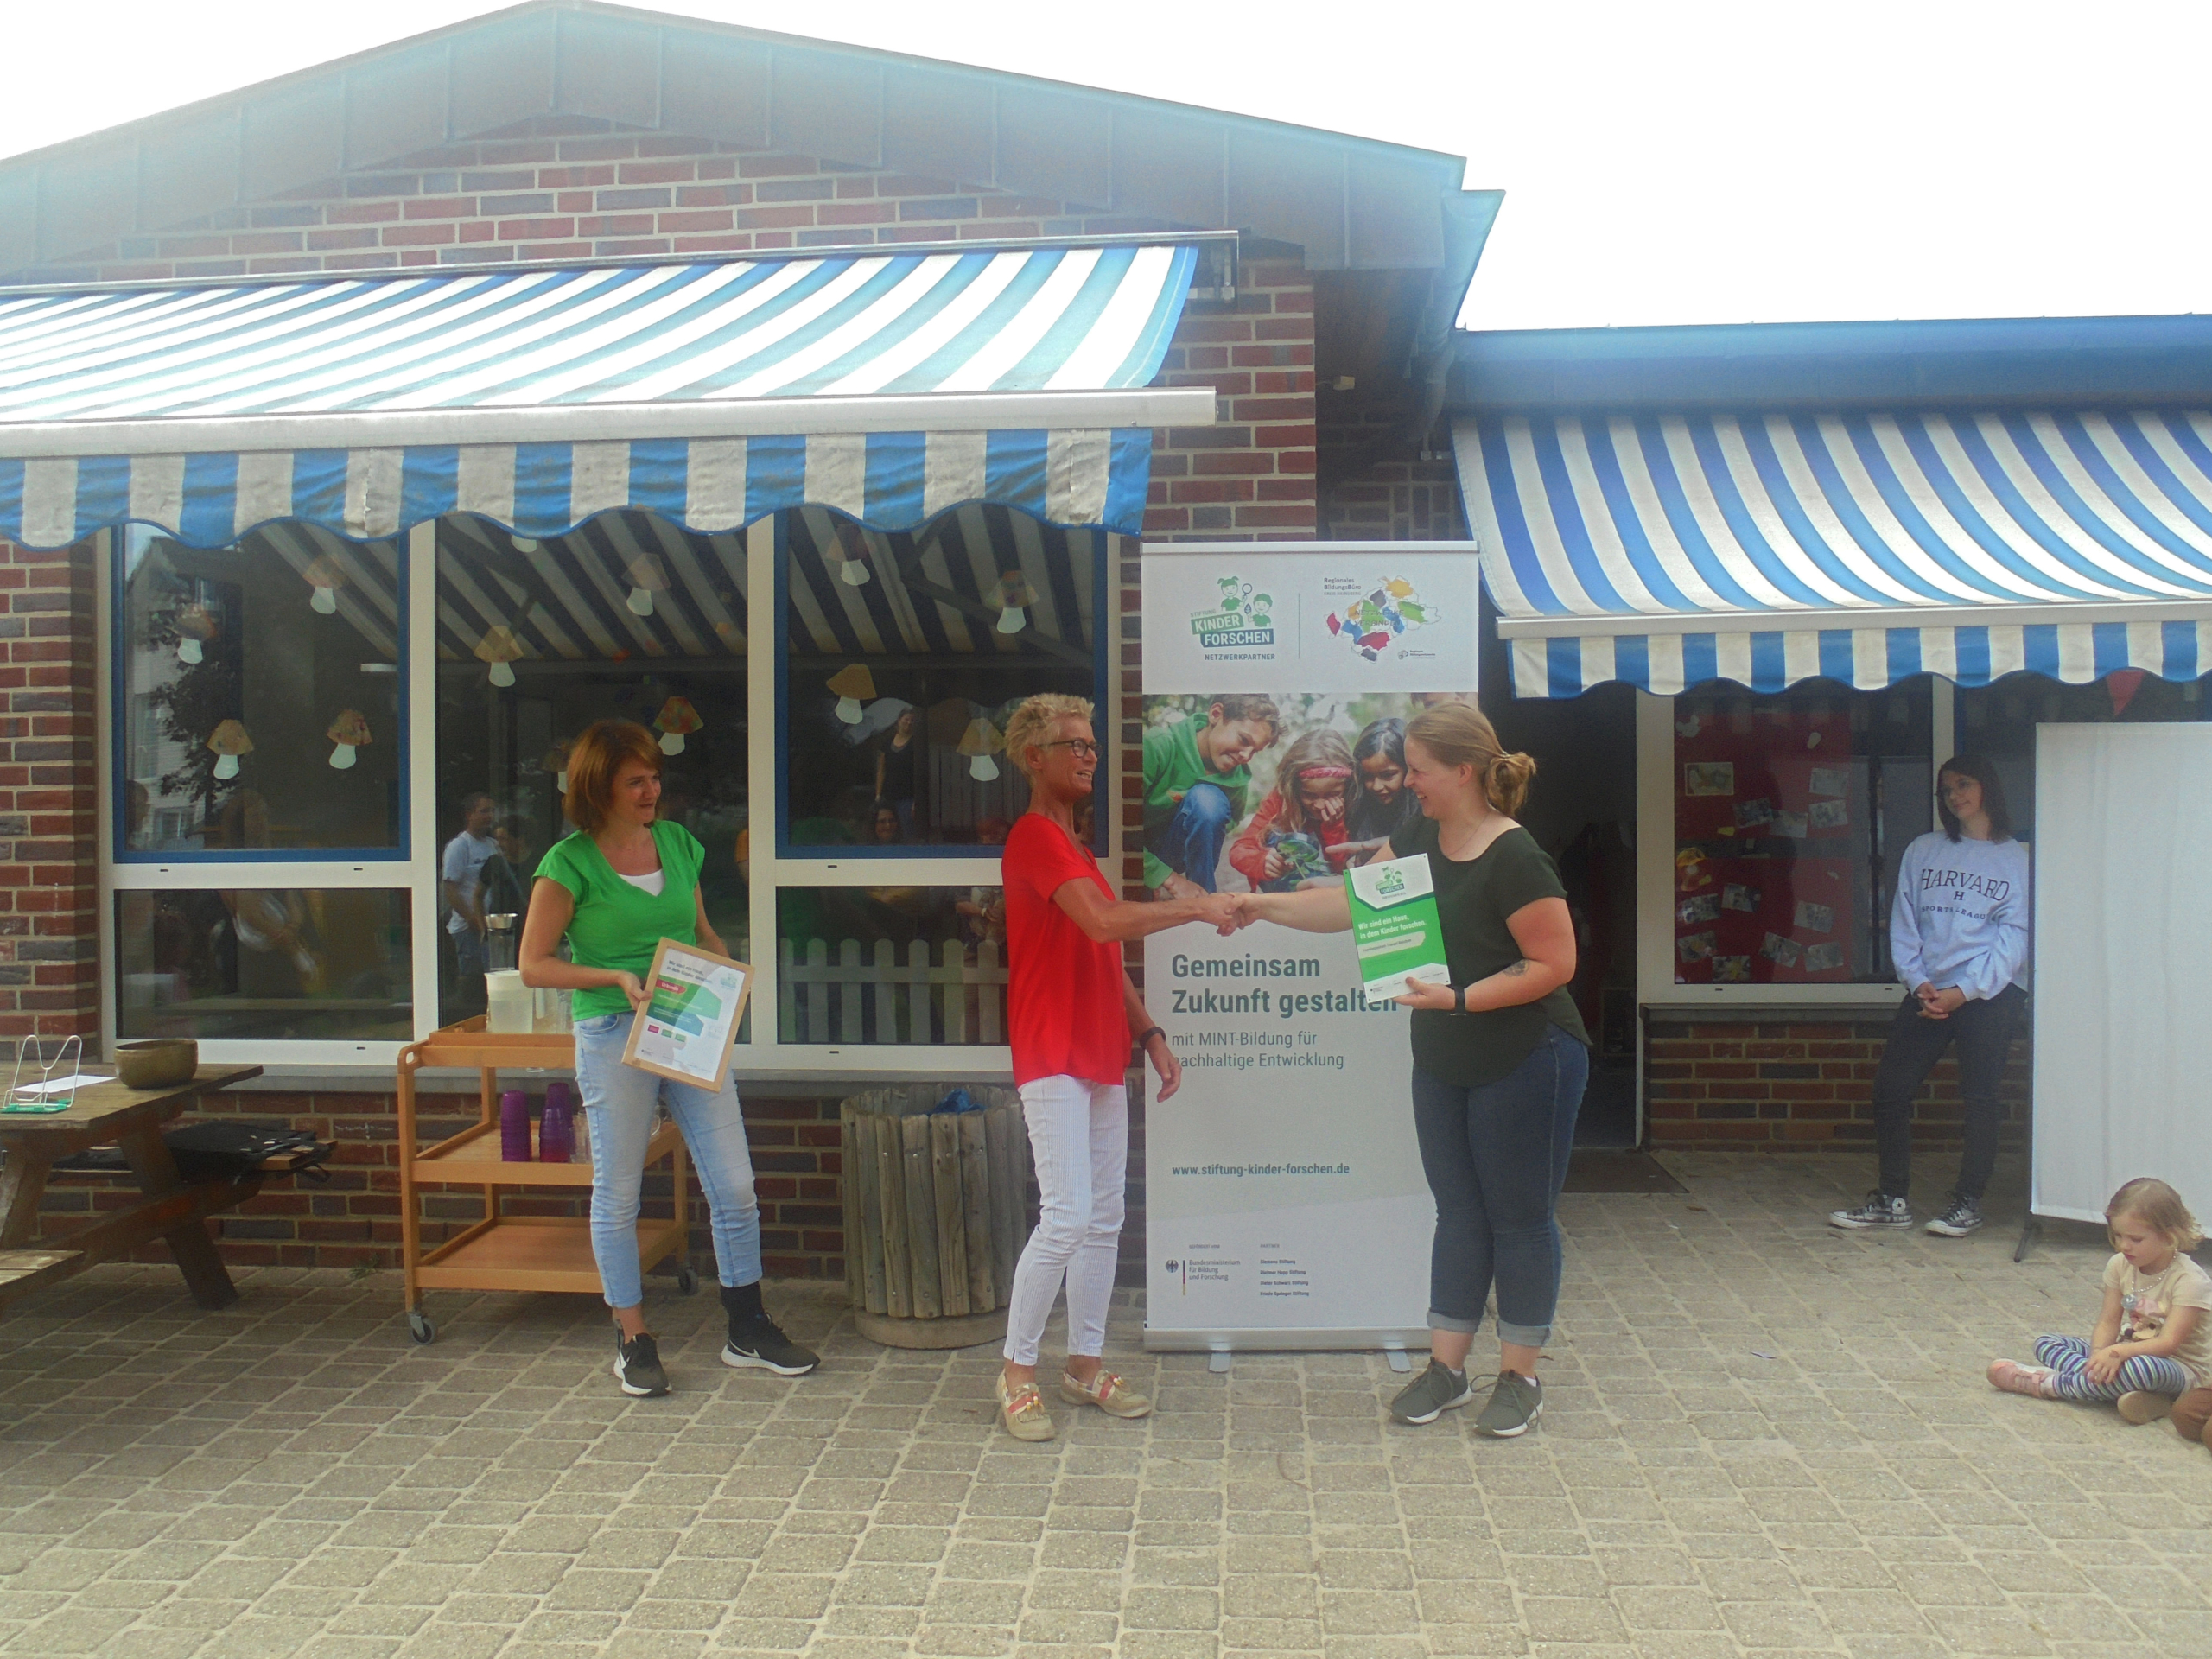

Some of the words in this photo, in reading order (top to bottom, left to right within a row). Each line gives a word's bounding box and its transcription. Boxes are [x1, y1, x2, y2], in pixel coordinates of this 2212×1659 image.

[1190, 609, 1217, 618] STIFTUNG
[1195, 615, 1241, 632] KINDER
[1205, 632, 1270, 646] FORSCHEN
[1922, 868, 2010, 901] HARVARD
[1953, 890, 1966, 901] H
[1955, 907, 1987, 920] LEAGU
[1172, 953, 1320, 978] Gemeinsam
[1172, 987, 1270, 1014] Zukunft
[1172, 1032, 1194, 1046] mit
[1198, 1031, 1293, 1048] MINT-Bildung
[1298, 1031, 1318, 1046] für
[1259, 1052, 1344, 1070] Entwicklung
[1172, 1162, 1350, 1177] www.stiftung-kinder-forschen.de
